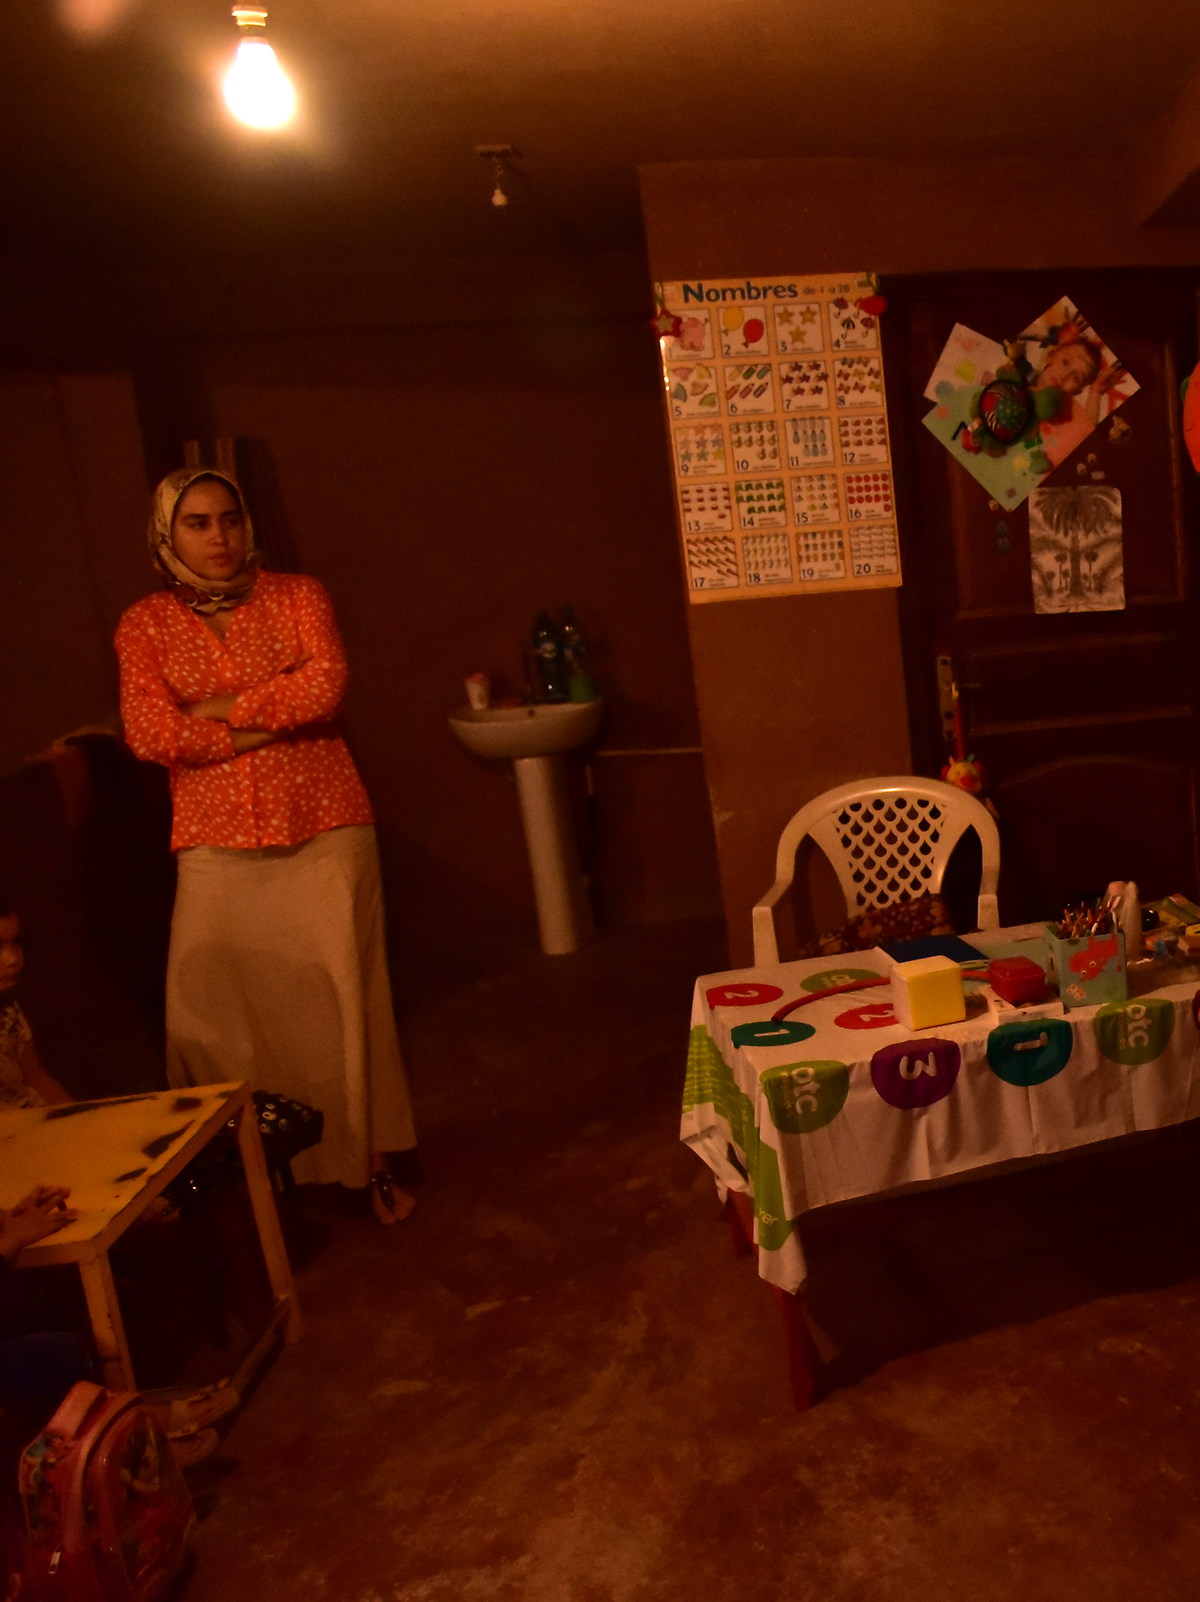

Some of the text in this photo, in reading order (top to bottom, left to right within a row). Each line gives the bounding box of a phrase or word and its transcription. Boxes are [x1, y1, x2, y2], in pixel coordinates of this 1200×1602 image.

[682, 281, 799, 304] Nombres
[780, 338, 788, 351] 3
[834, 338, 841, 348] 4
[724, 344, 732, 355] 2
[785, 399, 792, 409] 7
[837, 396, 845, 407] 8
[674, 406, 682, 417] 5
[730, 403, 738, 414] 6
[789, 456, 799, 467] 11
[843, 452, 856, 463] 12
[681, 464, 689, 475] 9
[735, 459, 749, 470] 10
[795, 512, 809, 523] 15
[849, 508, 862, 519] 16
[687, 520, 701, 532] 13
[742, 516, 755, 527] 14
[801, 568, 814, 579] 19
[856, 563, 872, 575] 20
[693, 577, 706, 588] 17
[748, 572, 761, 583] 18
[899, 1051, 938, 1082] 3
